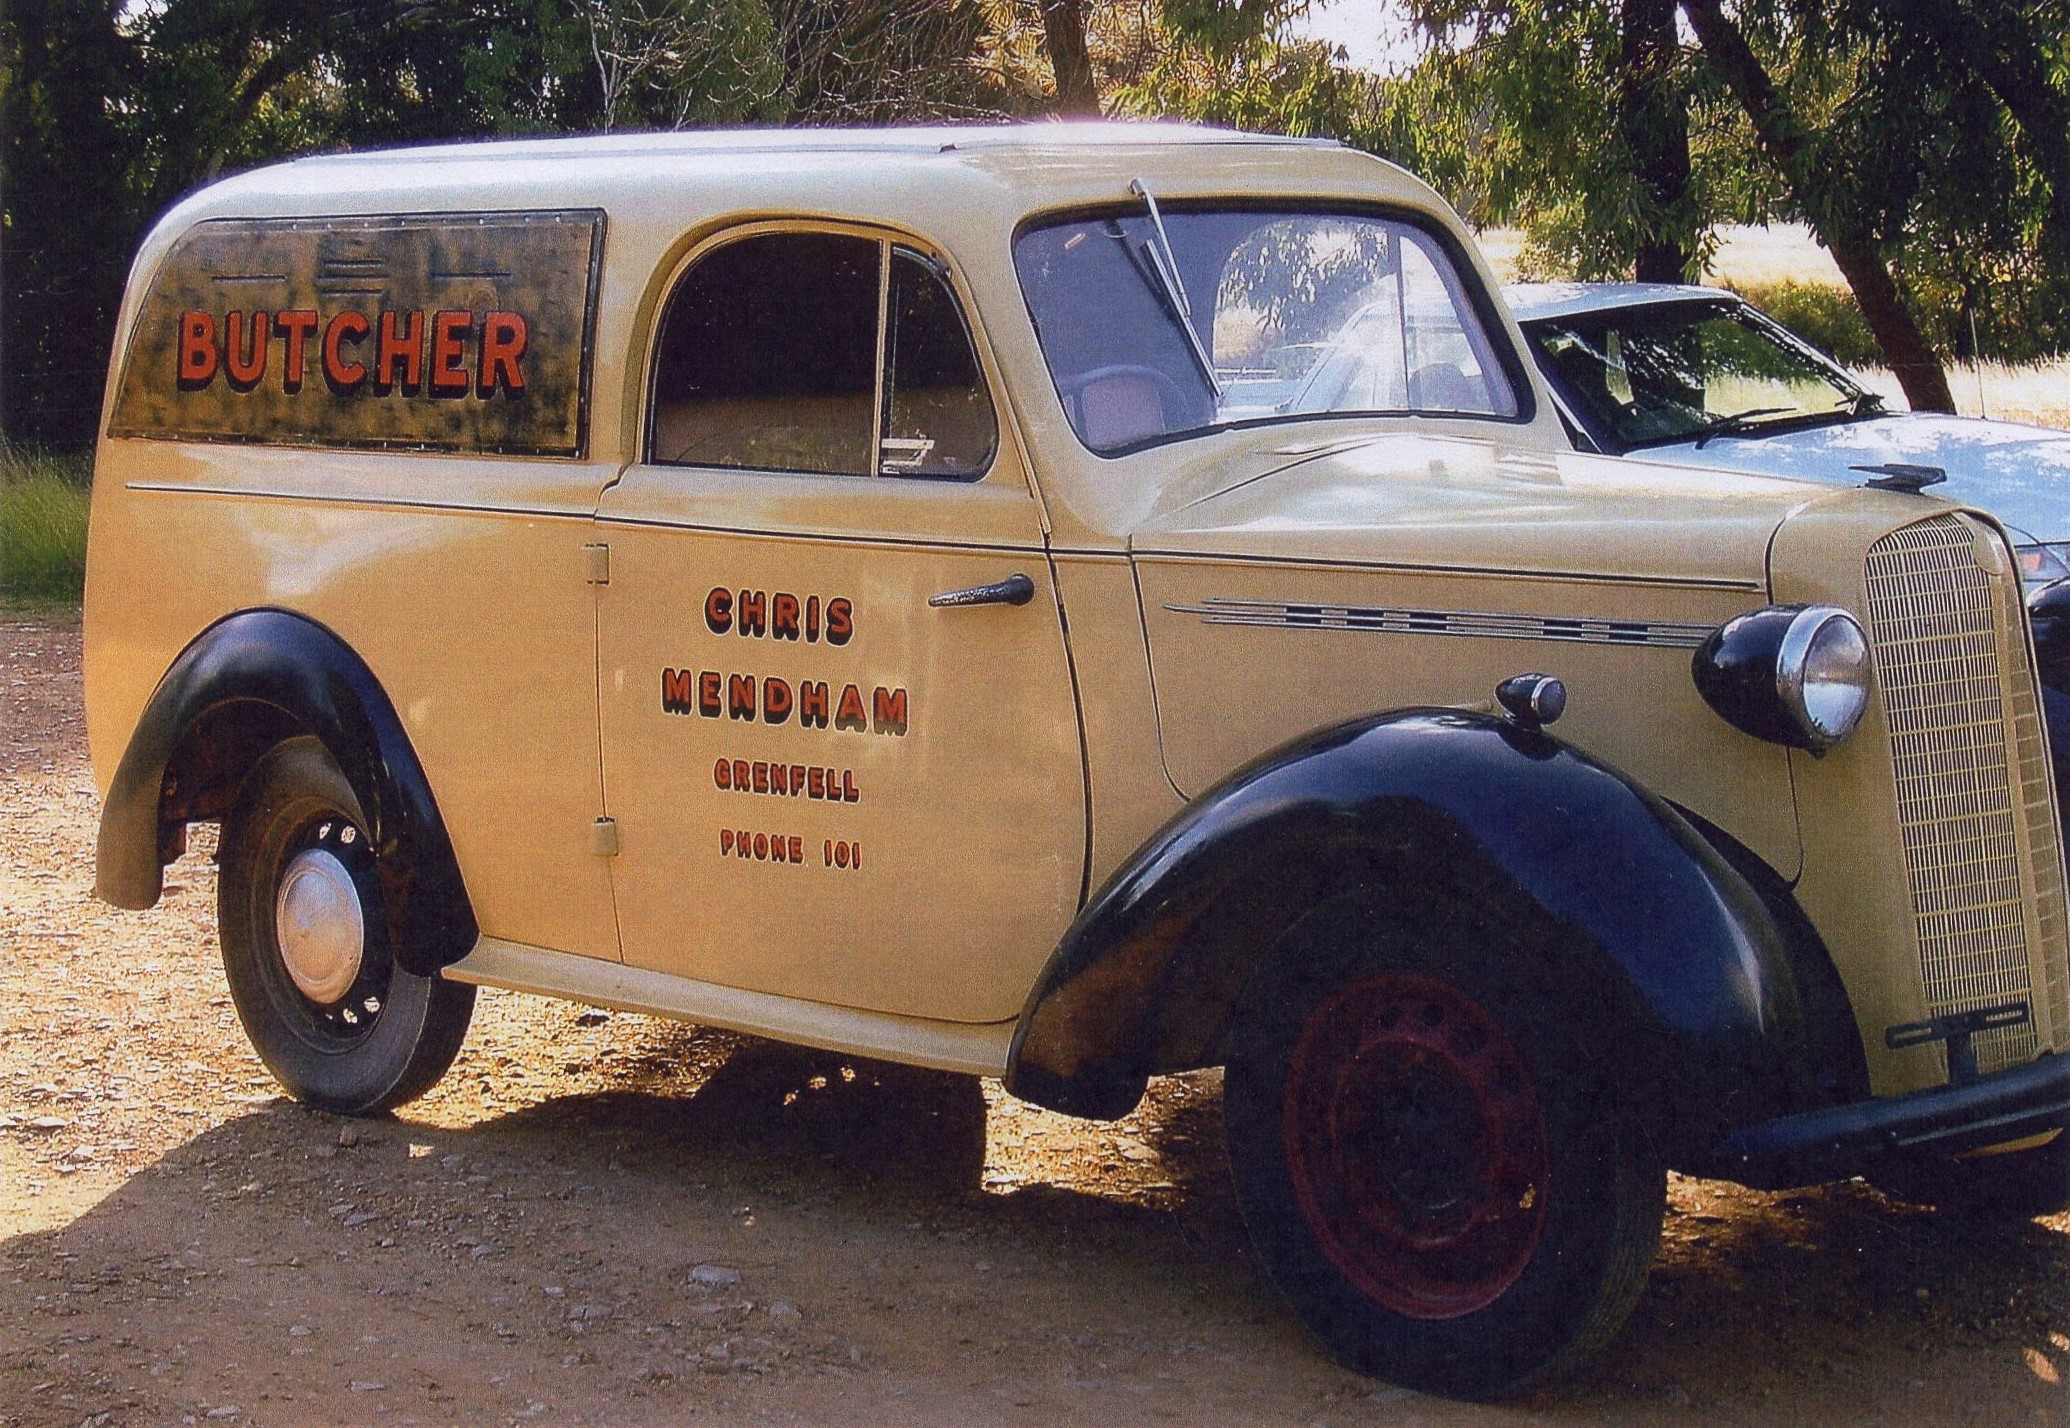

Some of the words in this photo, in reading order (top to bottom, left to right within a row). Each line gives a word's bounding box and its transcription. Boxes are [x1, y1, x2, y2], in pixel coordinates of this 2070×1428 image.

[177, 310, 528, 399] BUTCHER
[705, 586, 854, 646] CHRIS
[661, 667, 909, 737] MENDHAM
[714, 758, 861, 803] GRENFELL
[720, 829, 804, 864] PHONE
[824, 840, 862, 871] 101
